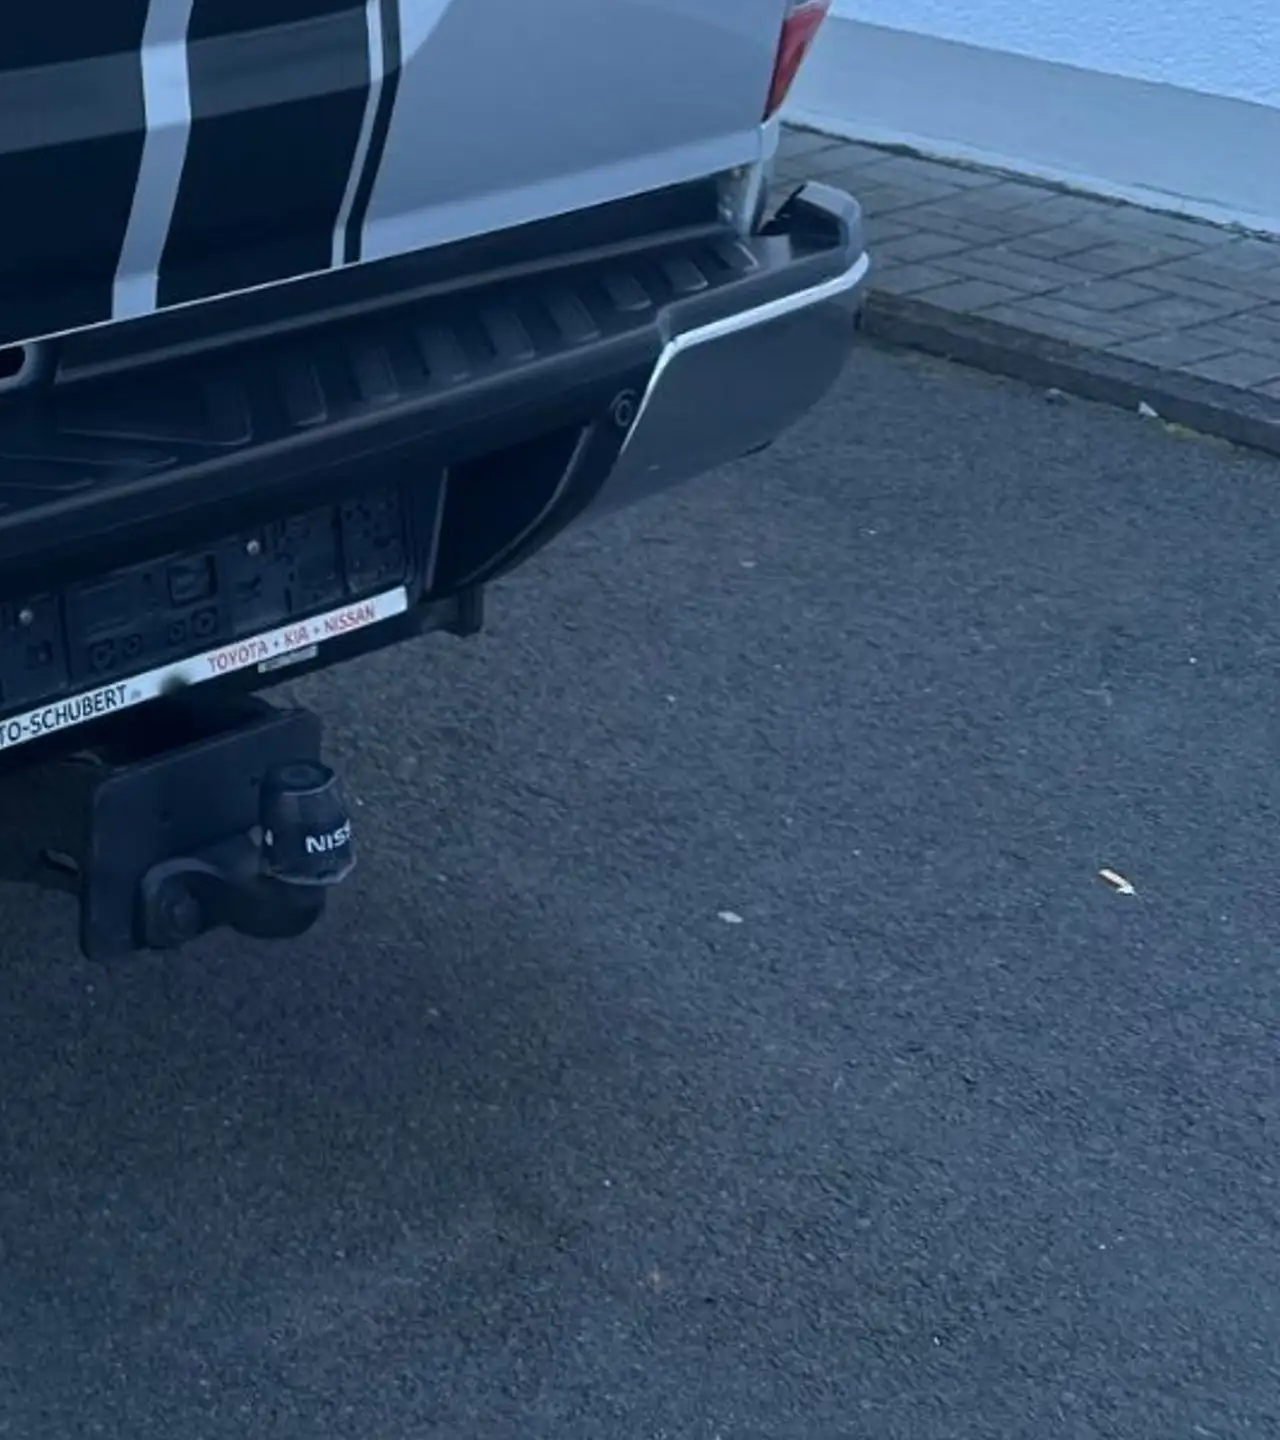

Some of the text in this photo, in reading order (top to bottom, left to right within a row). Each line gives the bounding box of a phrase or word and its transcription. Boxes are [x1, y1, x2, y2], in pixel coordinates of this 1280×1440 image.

[207, 640, 269, 673] TOYOTA
[283, 626, 310, 648] KIA
[324, 601, 376, 634] NISSAN
